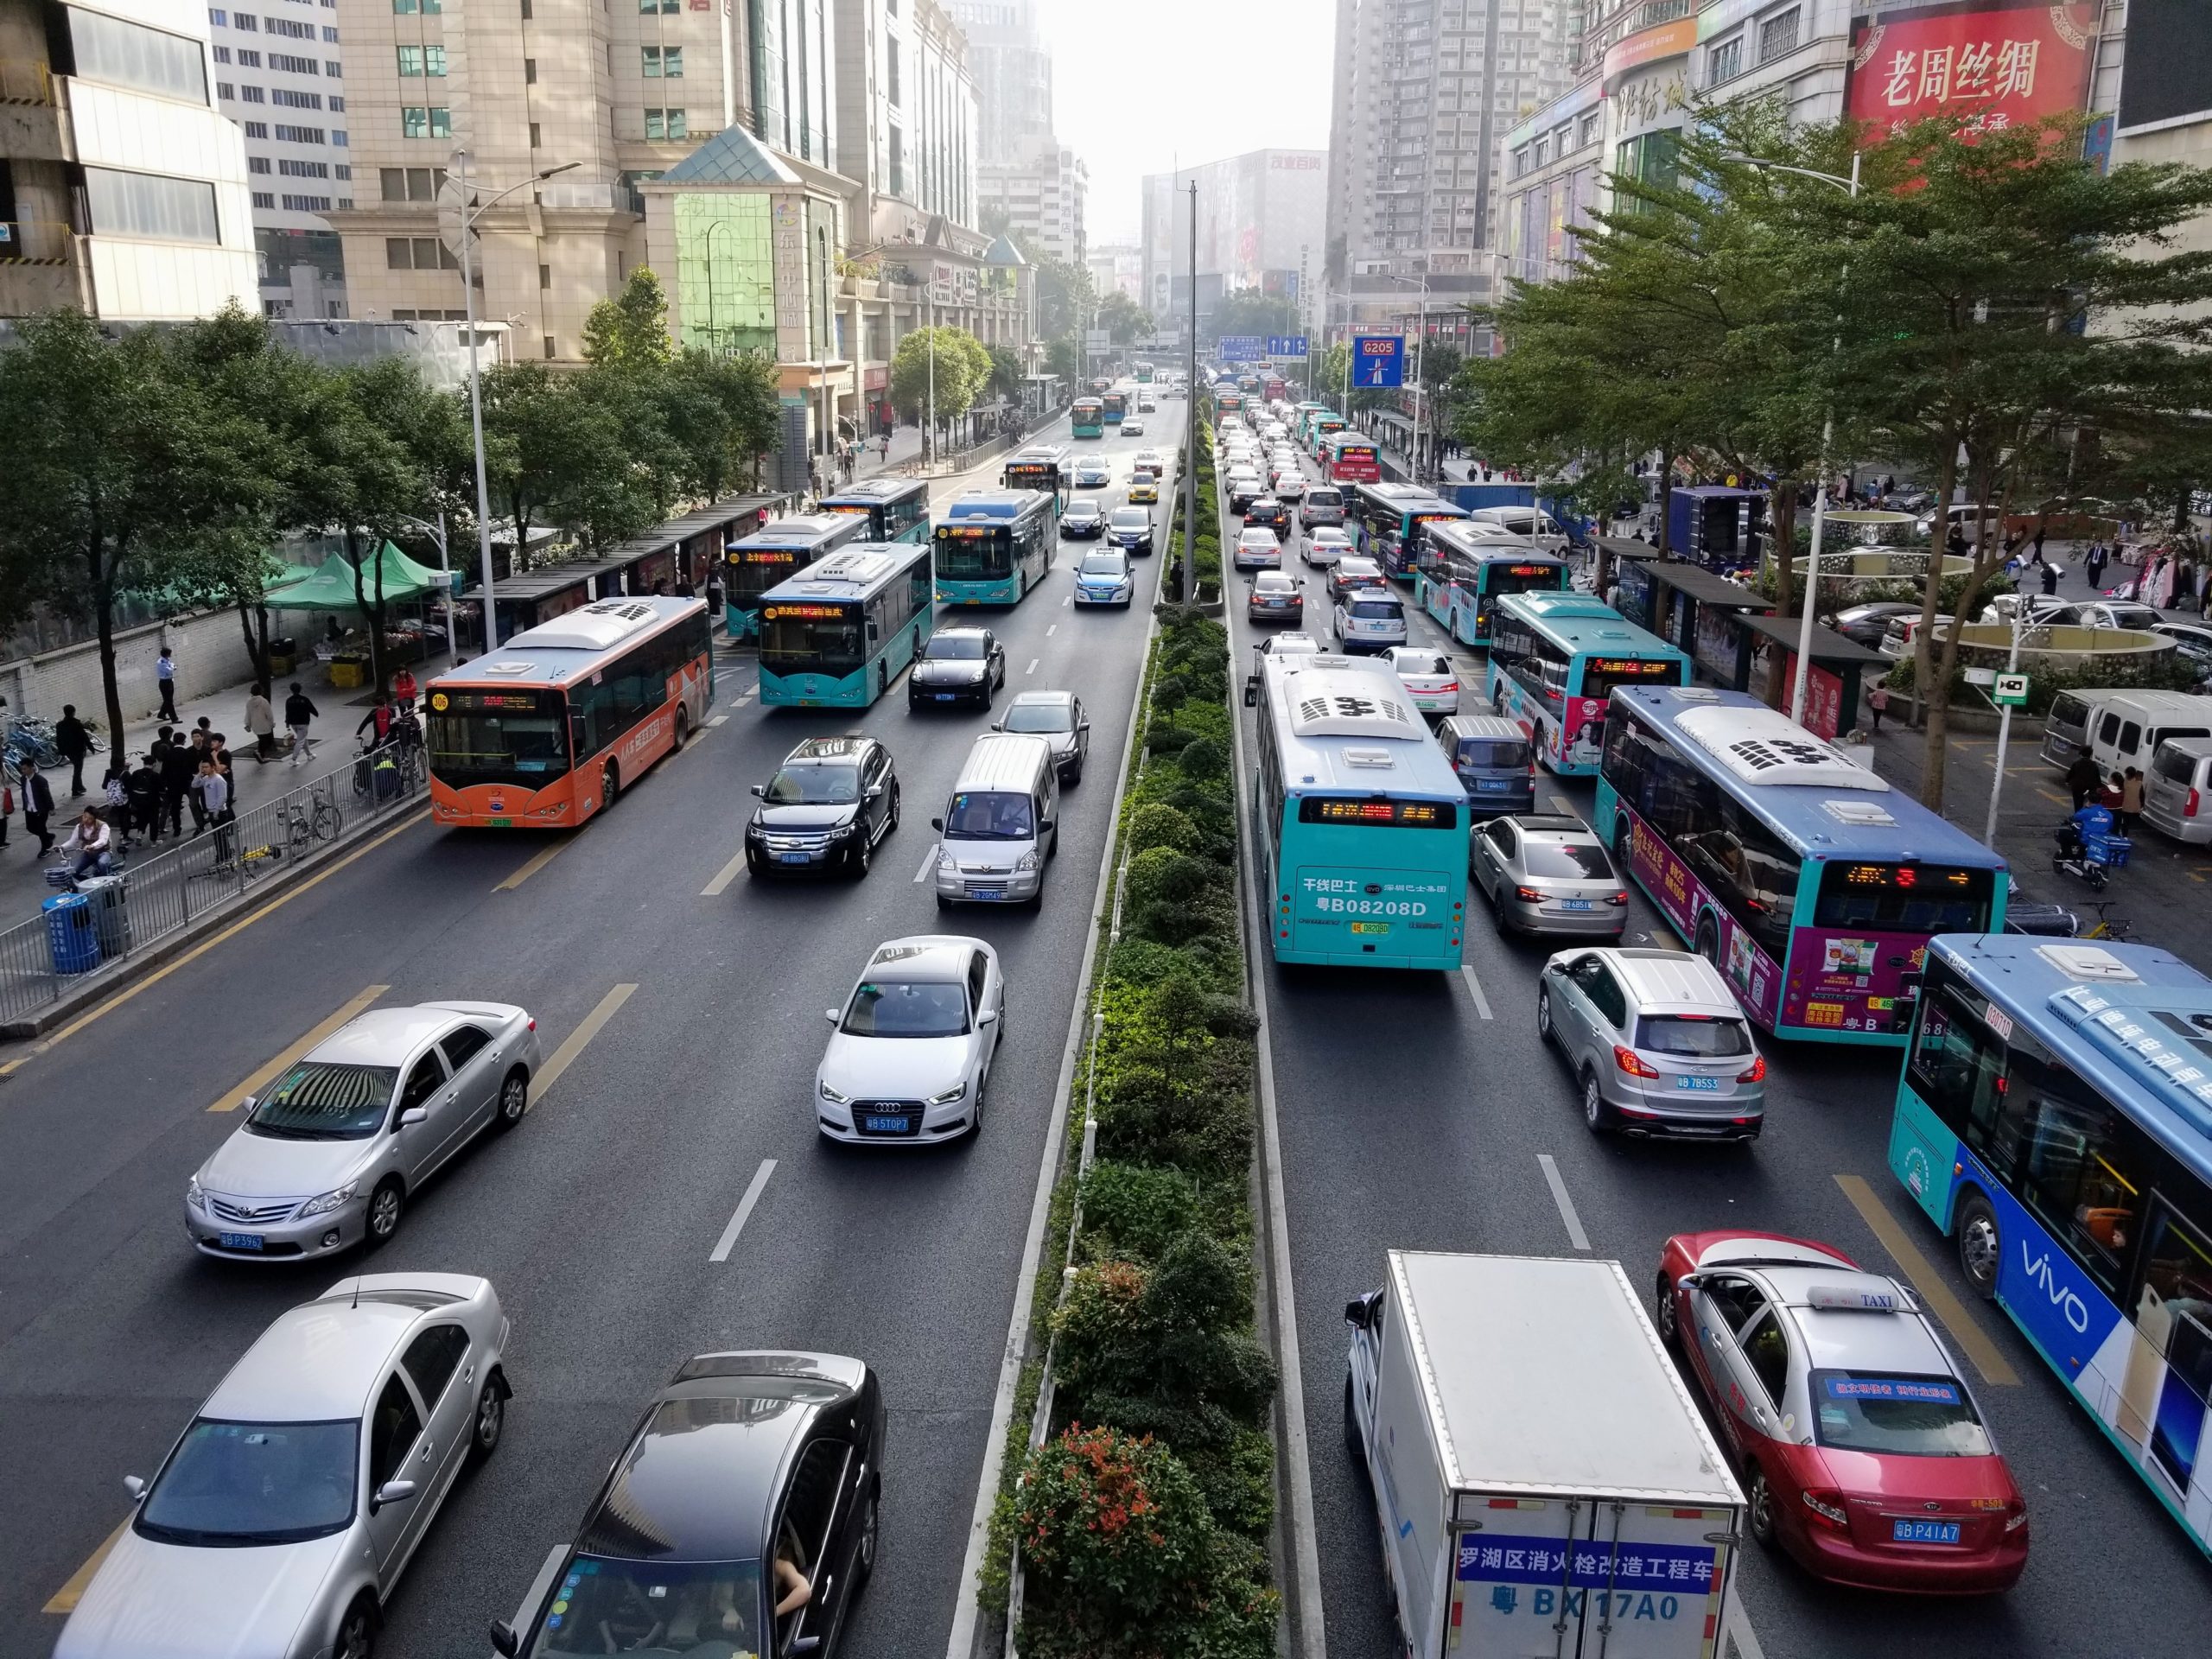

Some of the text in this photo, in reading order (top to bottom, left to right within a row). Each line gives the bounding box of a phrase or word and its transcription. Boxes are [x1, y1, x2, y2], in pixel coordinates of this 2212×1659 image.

[1881, 39, 2041, 106] 老周丝绸
[779, 232, 798, 328] 东门中心城
[1364, 342, 1393, 353] G205
[434, 696, 447, 708] 306
[1303, 878, 1357, 893] 干线巴士
[1383, 884, 1447, 893] 深圳巴士集团
[1316, 897, 1426, 916] 粤B08208D
[2022, 1240, 2089, 1334] vivo
[1861, 1294, 1893, 1309] TAXI
[1459, 1547, 1713, 1581] 罗湖区消火栓改造工程车
